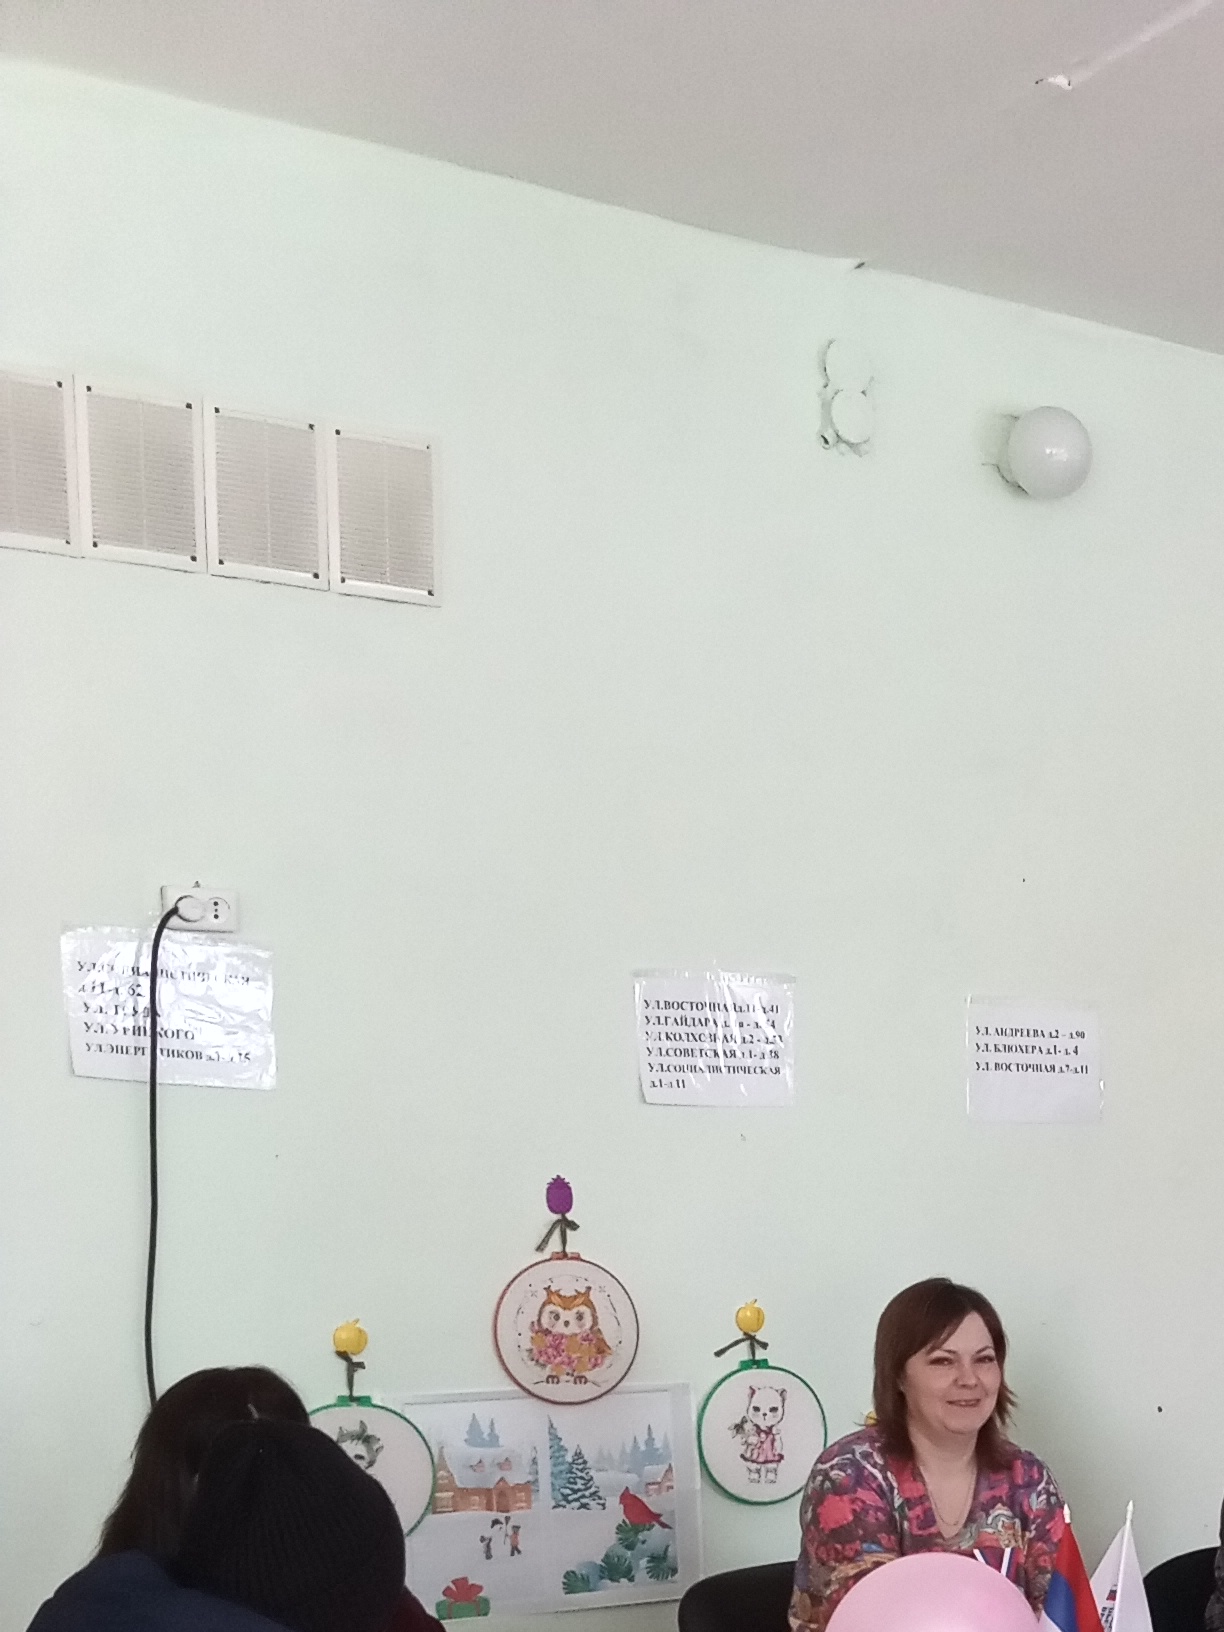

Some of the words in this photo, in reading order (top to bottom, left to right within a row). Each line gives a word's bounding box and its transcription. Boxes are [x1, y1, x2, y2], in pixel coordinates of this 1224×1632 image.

[994, 1027, 1046, 1039] АНДРЕЕВА
[85, 1043, 203, 1060] УЛ.ЭНЕРГТИКОВ
[993, 1043, 1043, 1055] БЛЮХЕРА
[994, 1062, 1056, 1073] ВОСТОЧНАЯ
